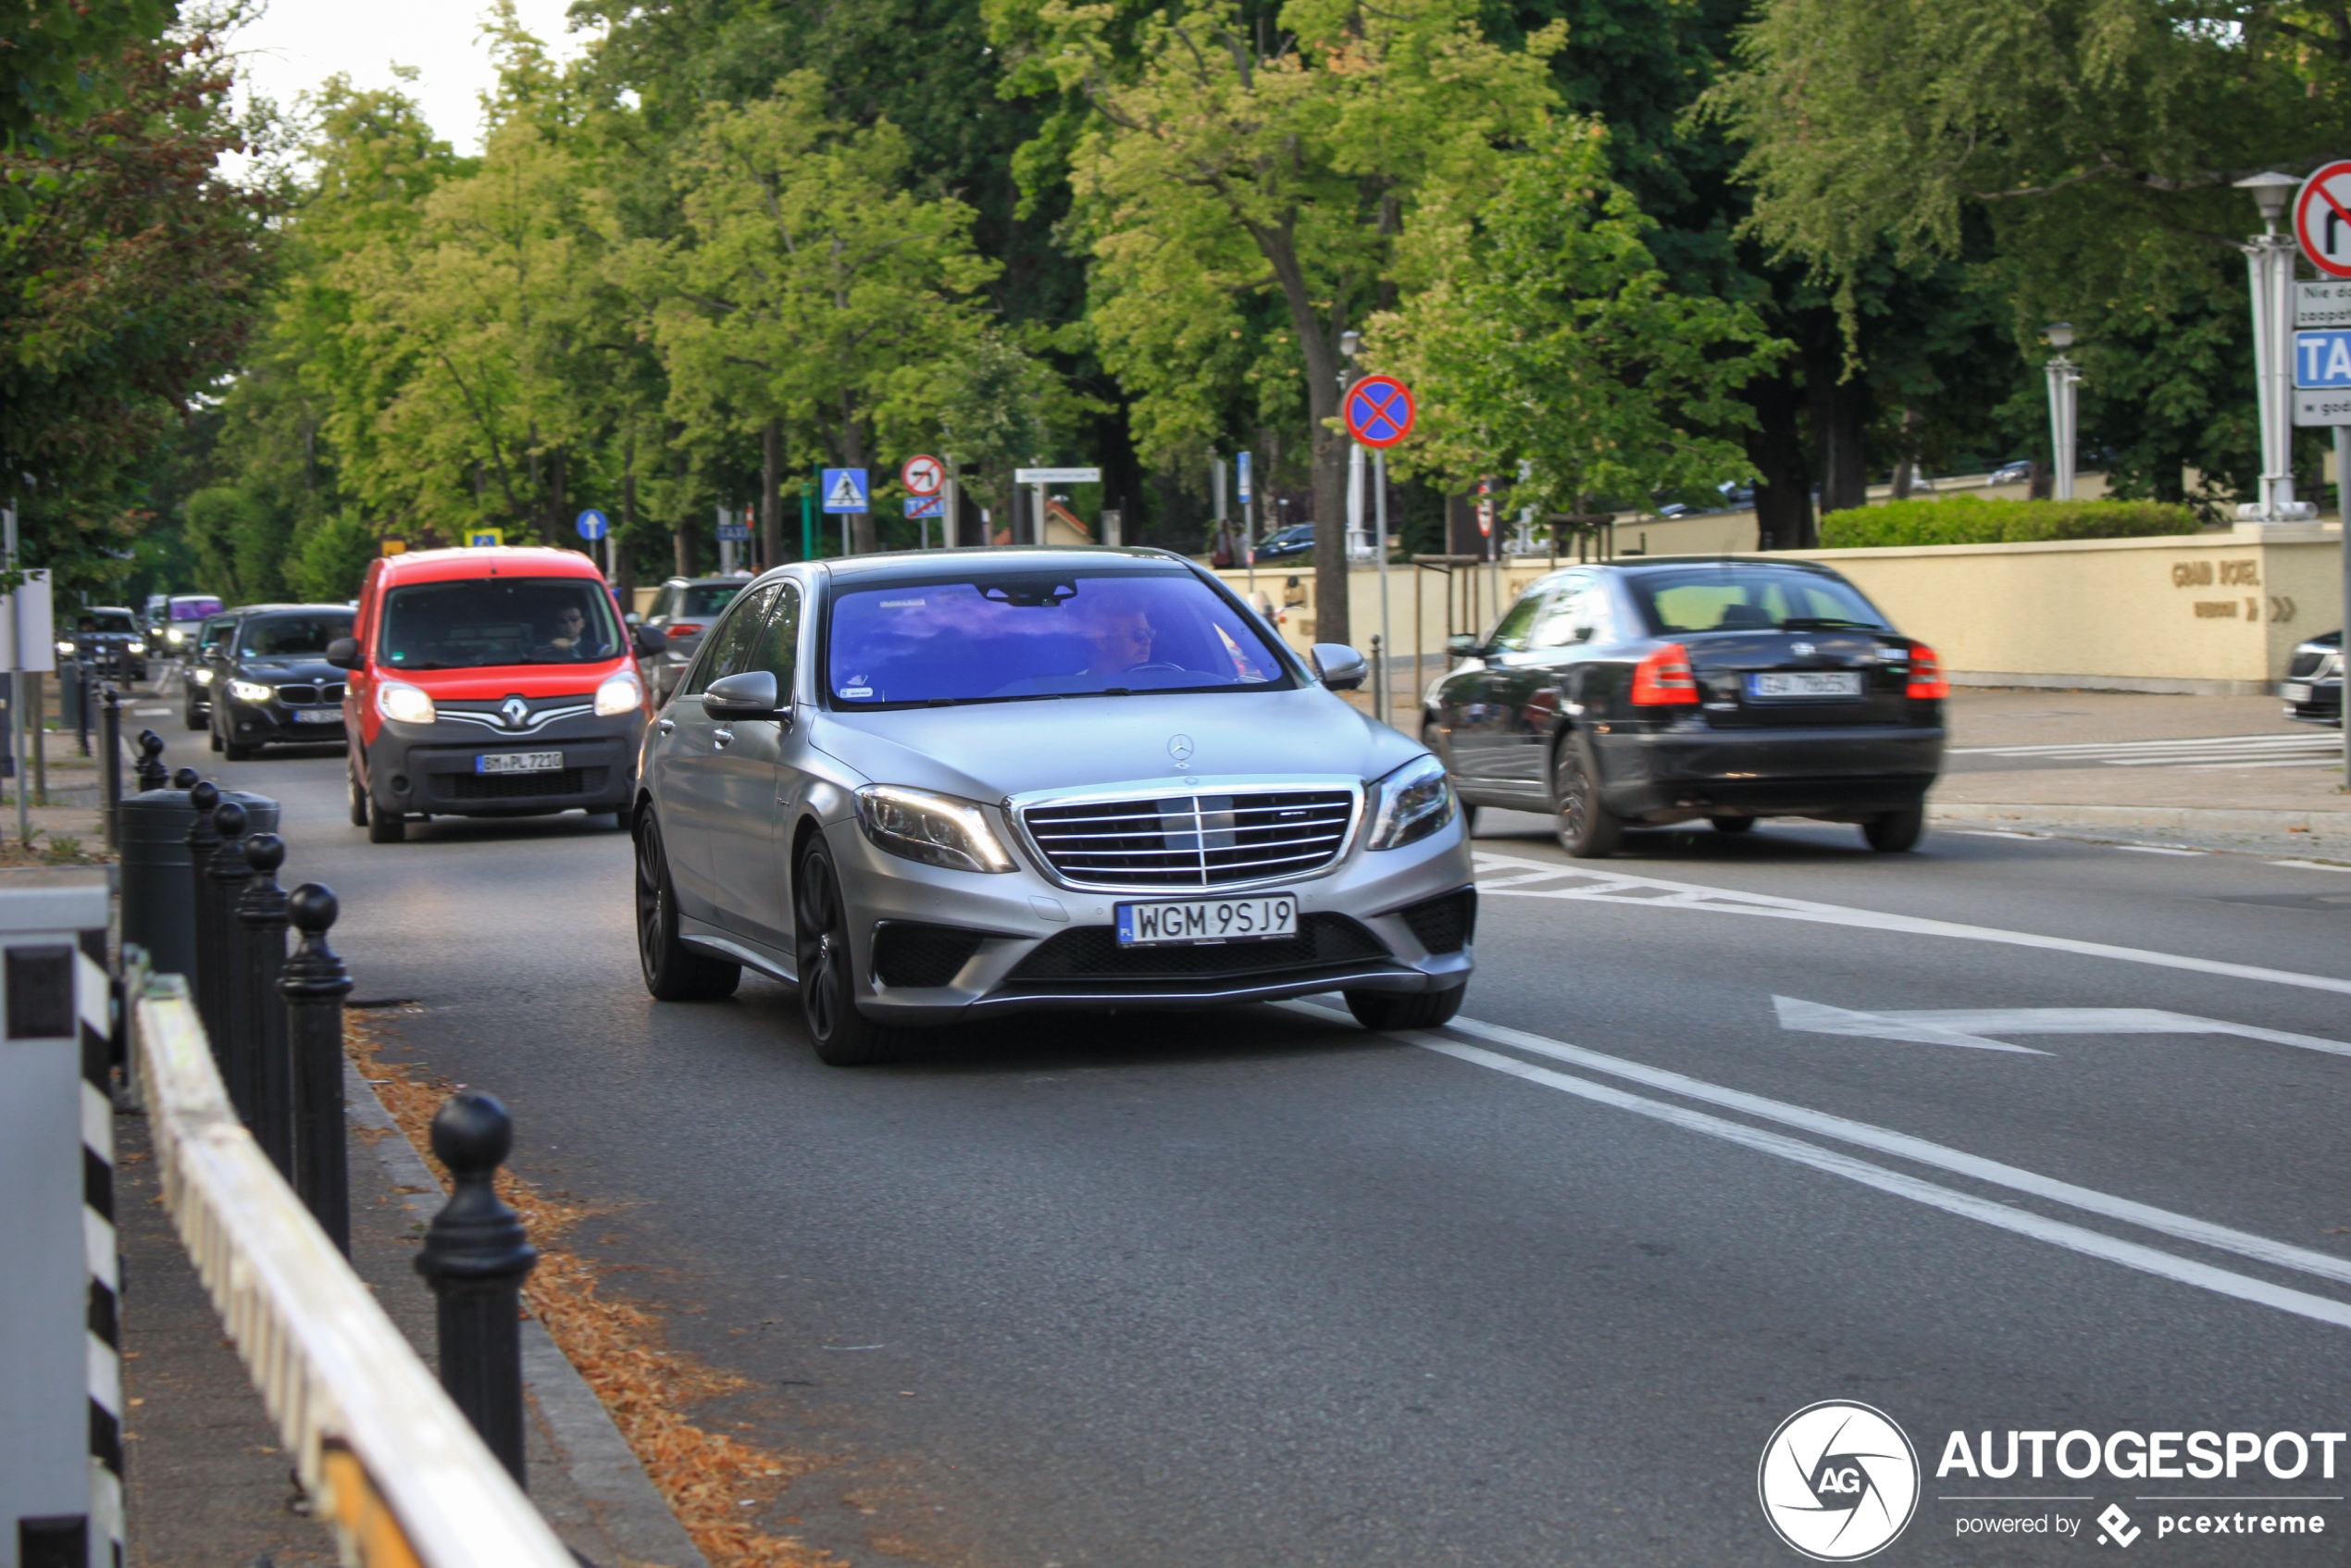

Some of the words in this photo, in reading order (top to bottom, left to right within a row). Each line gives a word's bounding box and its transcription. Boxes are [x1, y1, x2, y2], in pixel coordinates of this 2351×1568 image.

[2304, 285, 2332, 299] Nie
[2298, 337, 2351, 381] TA
[906, 499, 945, 516] TAXI
[1138, 905, 1207, 938] WGM
[1217, 901, 1291, 934] 9SJ9
[1121, 927, 1133, 938] PL
